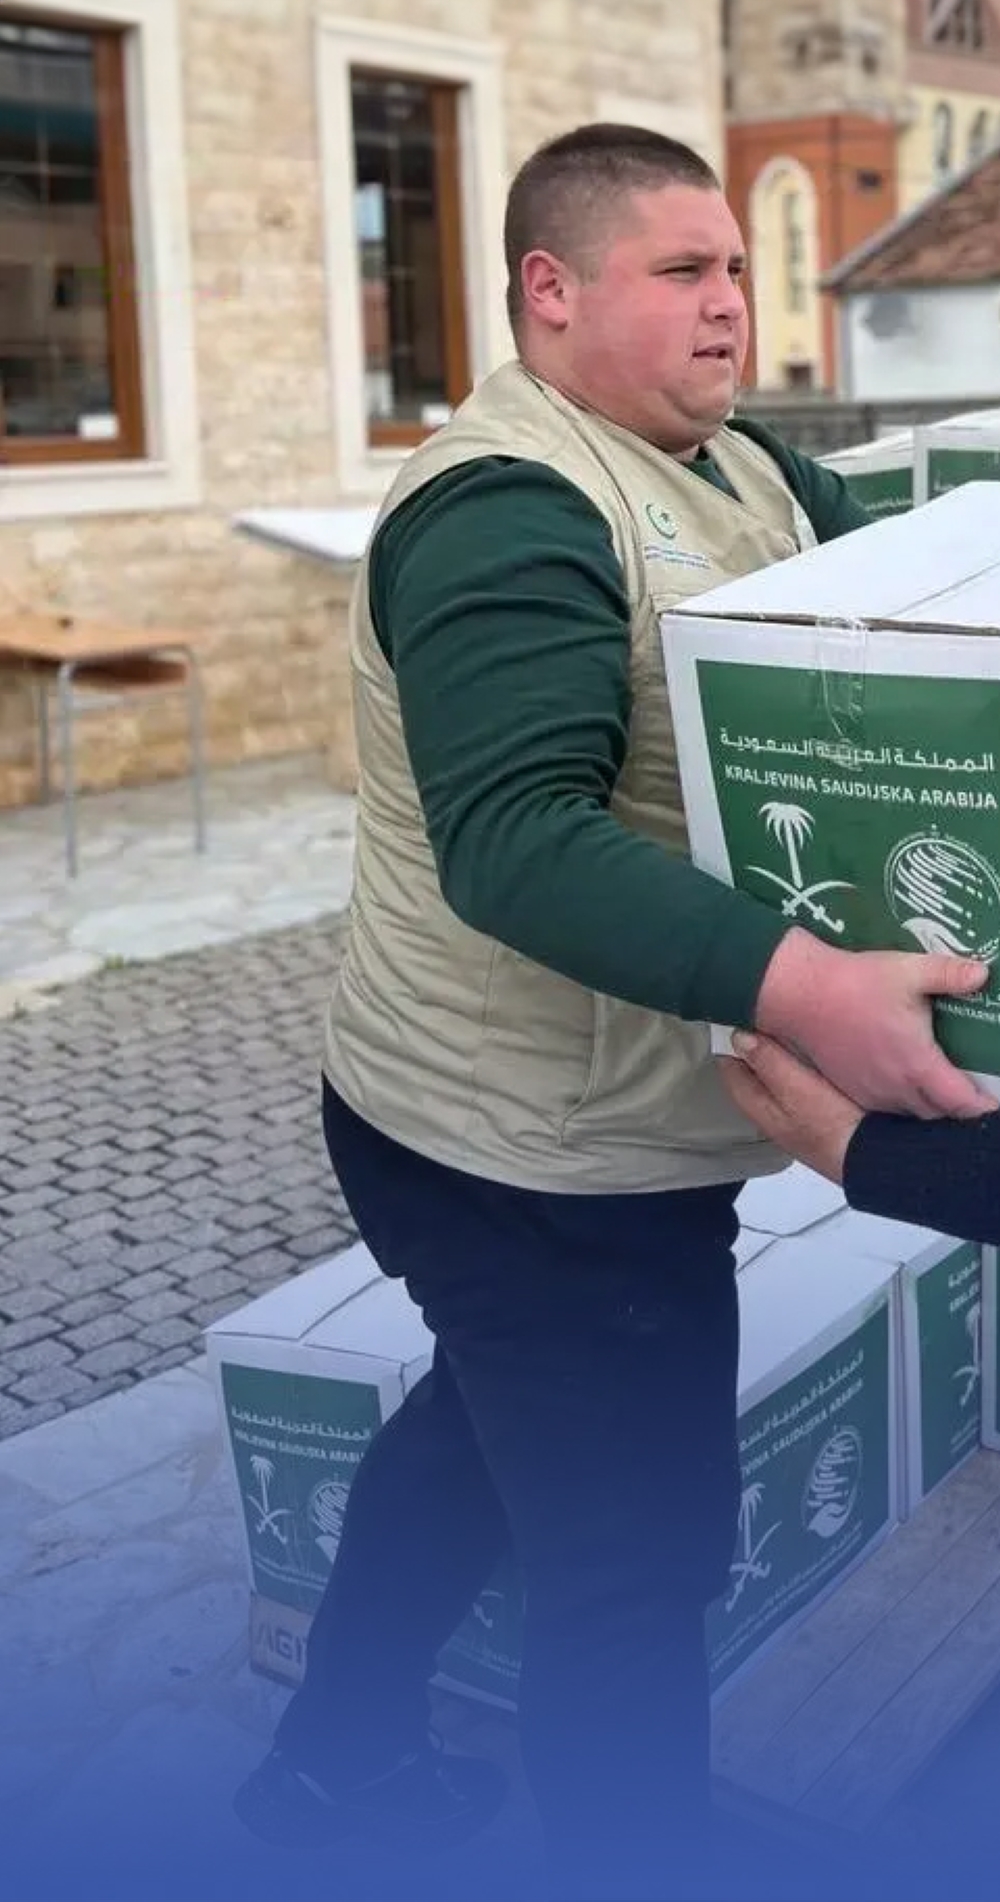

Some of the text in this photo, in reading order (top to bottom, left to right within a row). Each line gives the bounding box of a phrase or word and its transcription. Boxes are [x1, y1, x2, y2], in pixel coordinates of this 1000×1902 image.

[720, 727, 813, 757] السعودية
[894, 748, 995, 772] المملكة
[725, 765, 998, 809] KRALJEVINA SAUDIJSKA ARABIJA
